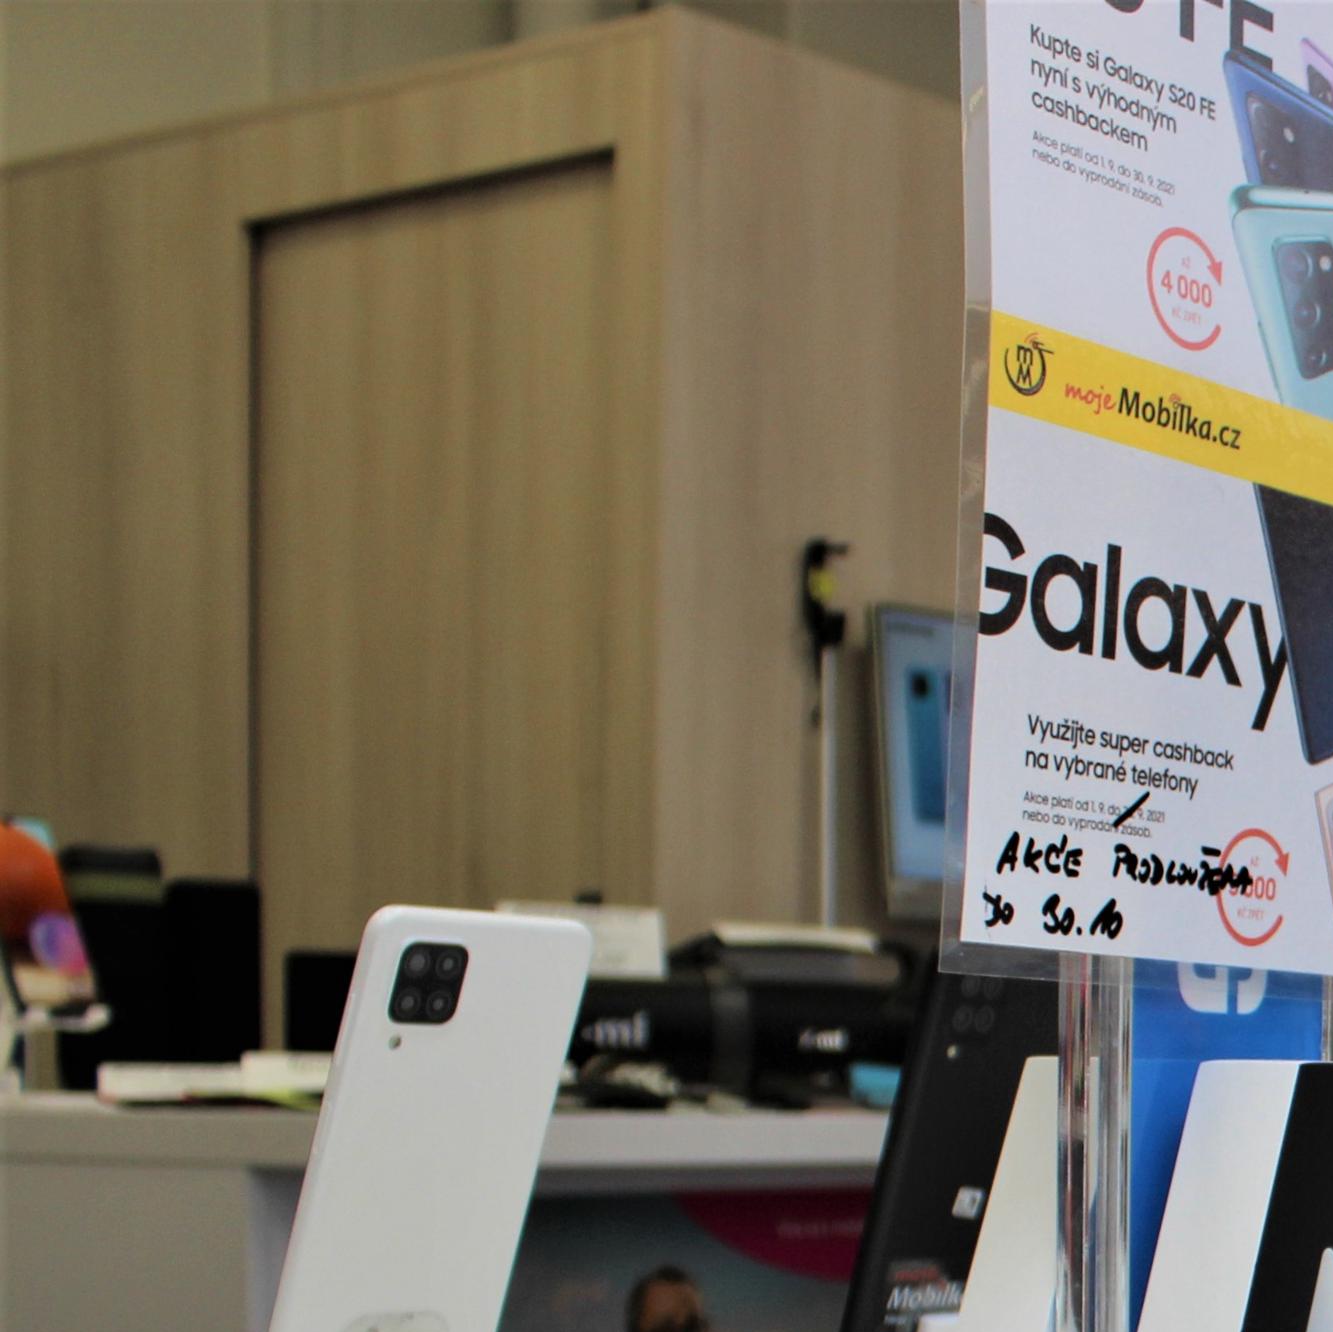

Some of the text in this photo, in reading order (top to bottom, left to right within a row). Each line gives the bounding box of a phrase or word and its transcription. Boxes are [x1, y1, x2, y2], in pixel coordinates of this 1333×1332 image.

[1030, 23, 1216, 121] Kupte si Galaxy S20 FE
[1031, 58, 1177, 134] nyní s výhodným
[1031, 91, 1149, 152] cashbackem
[1032, 130, 1058, 150] Akce
[1085, 151, 1099, 167] od
[1118, 164, 1132, 179] do
[1032, 149, 1060, 168] nebo
[1062, 159, 1077, 174] do
[1161, 269, 1213, 309] 4 000
[978, 512, 1288, 731] Galaxy
[1028, 714, 1234, 771] Využijte super cashback
[1025, 750, 1199, 800] na vybrané telefony
[1022, 808, 1050, 824] nebo
[1051, 811, 1067, 827] do
[1023, 790, 1049, 806] Akce
[1075, 798, 1089, 812] od
